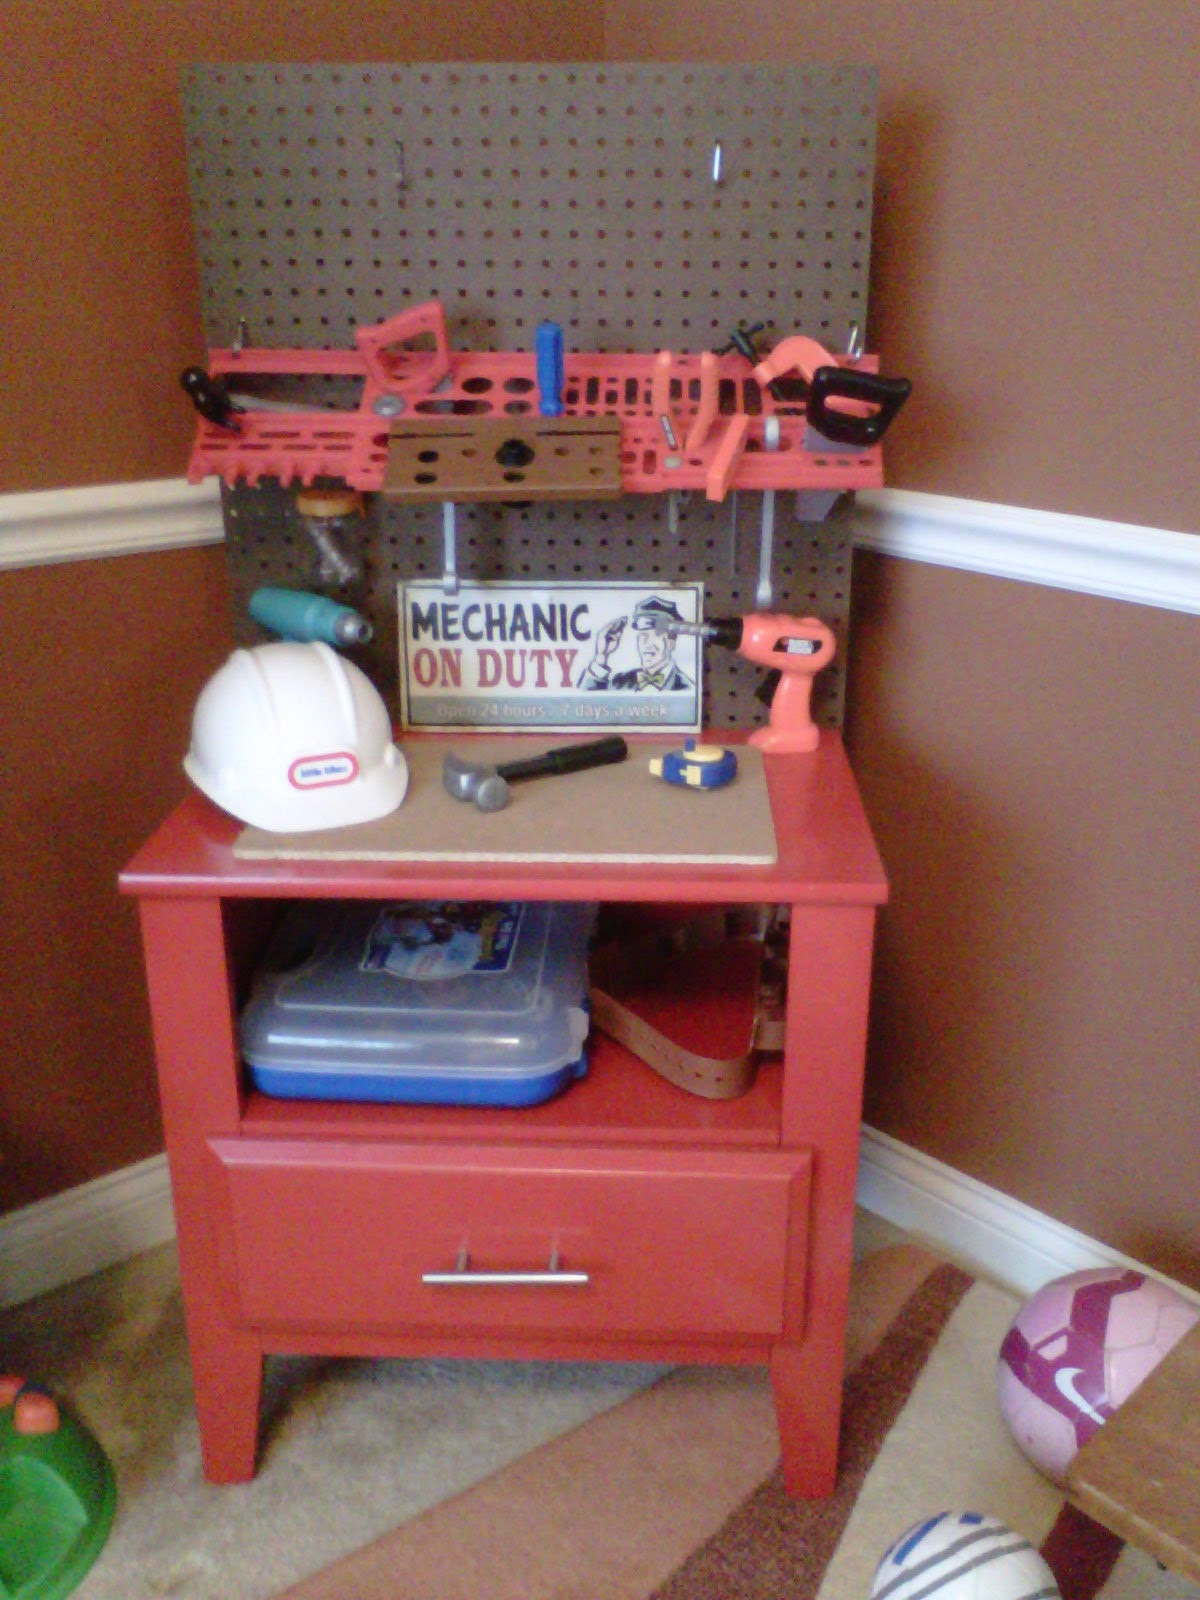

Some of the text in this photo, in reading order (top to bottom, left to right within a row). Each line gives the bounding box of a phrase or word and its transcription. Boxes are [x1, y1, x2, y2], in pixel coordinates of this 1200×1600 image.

[411, 601, 591, 642] MECHANIC
[413, 648, 578, 688] ON DUTY
[503, 703, 545, 717] hours
[575, 702, 609, 720] days
[614, 706, 623, 717] a
[628, 702, 667, 717] week
